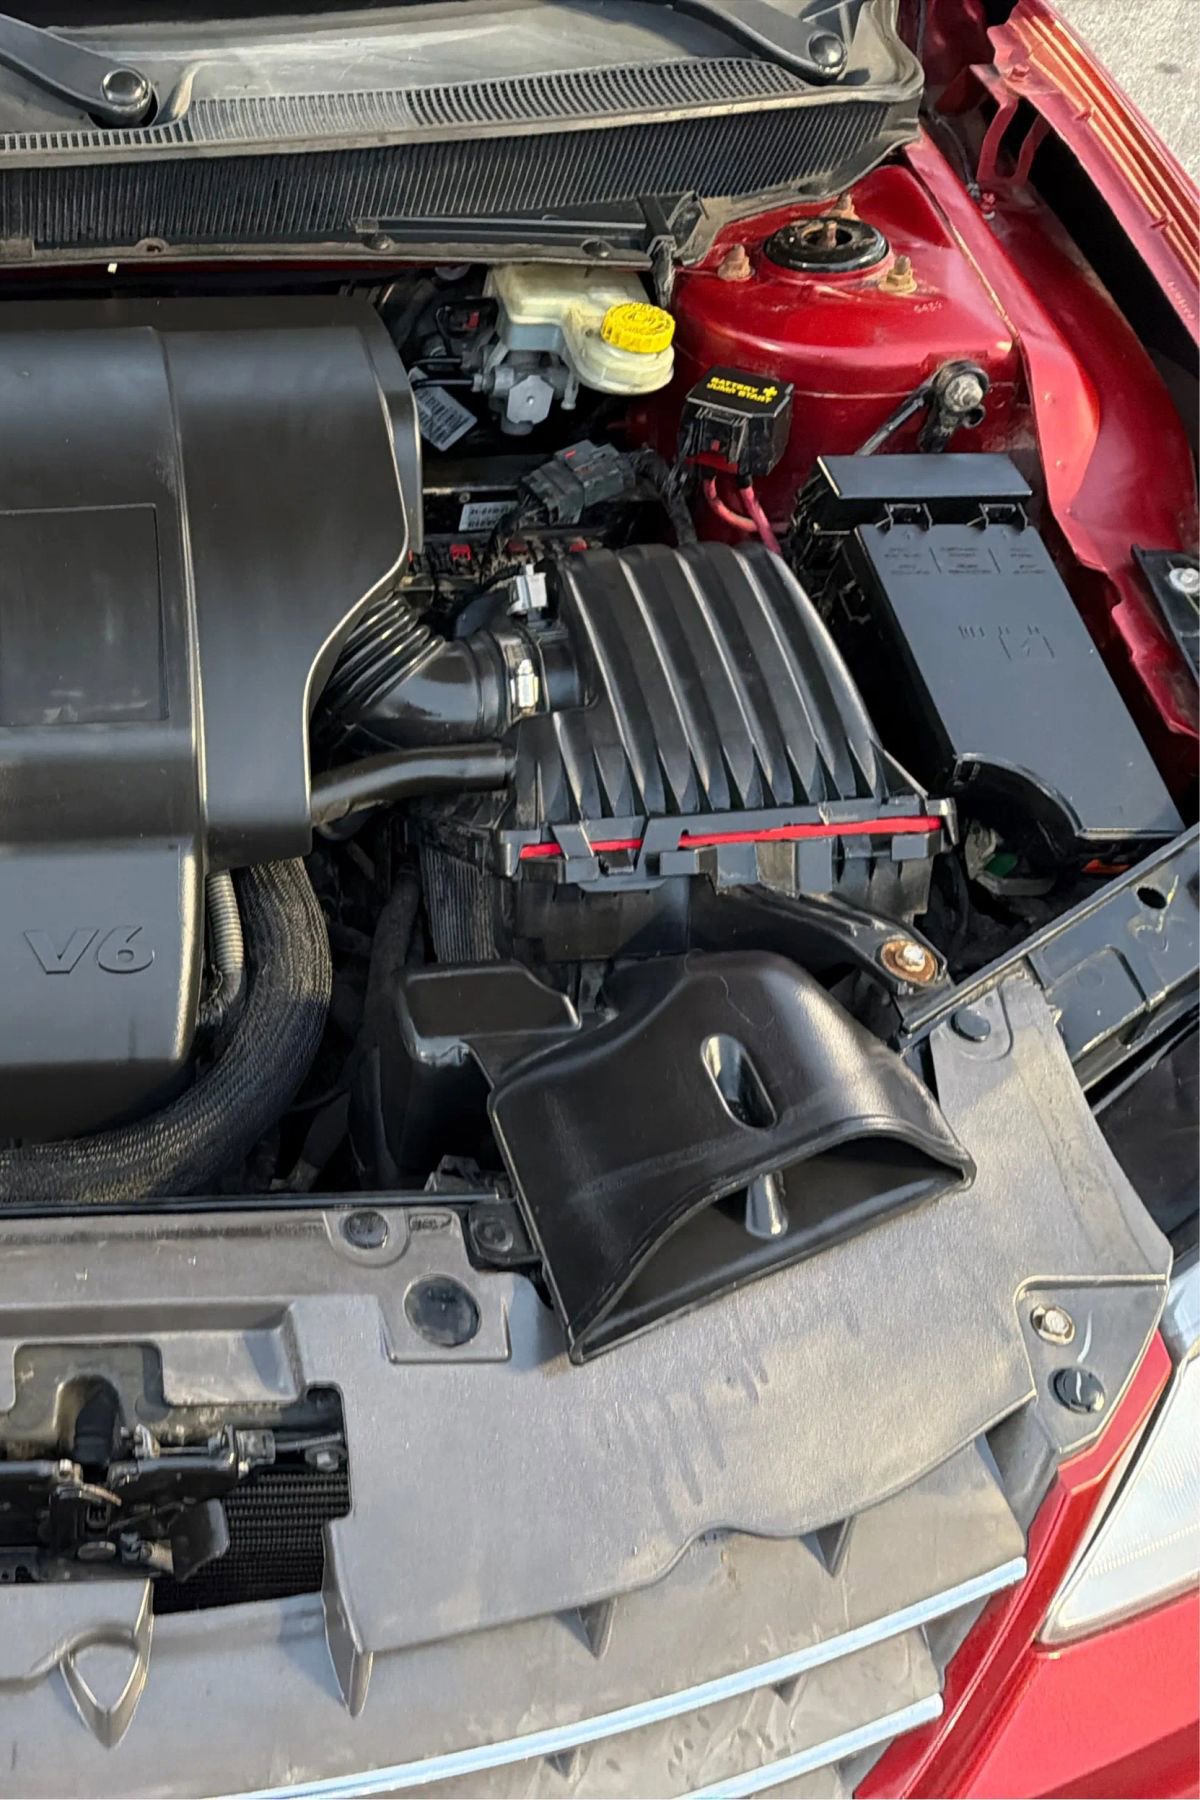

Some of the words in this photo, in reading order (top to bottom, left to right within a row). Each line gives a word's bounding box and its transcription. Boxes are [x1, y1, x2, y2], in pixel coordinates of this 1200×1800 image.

[706, 382, 737, 394] JUMP
[737, 390, 773, 404] START
[710, 377, 758, 393] BATTERY
[22, 925, 155, 976] V6
